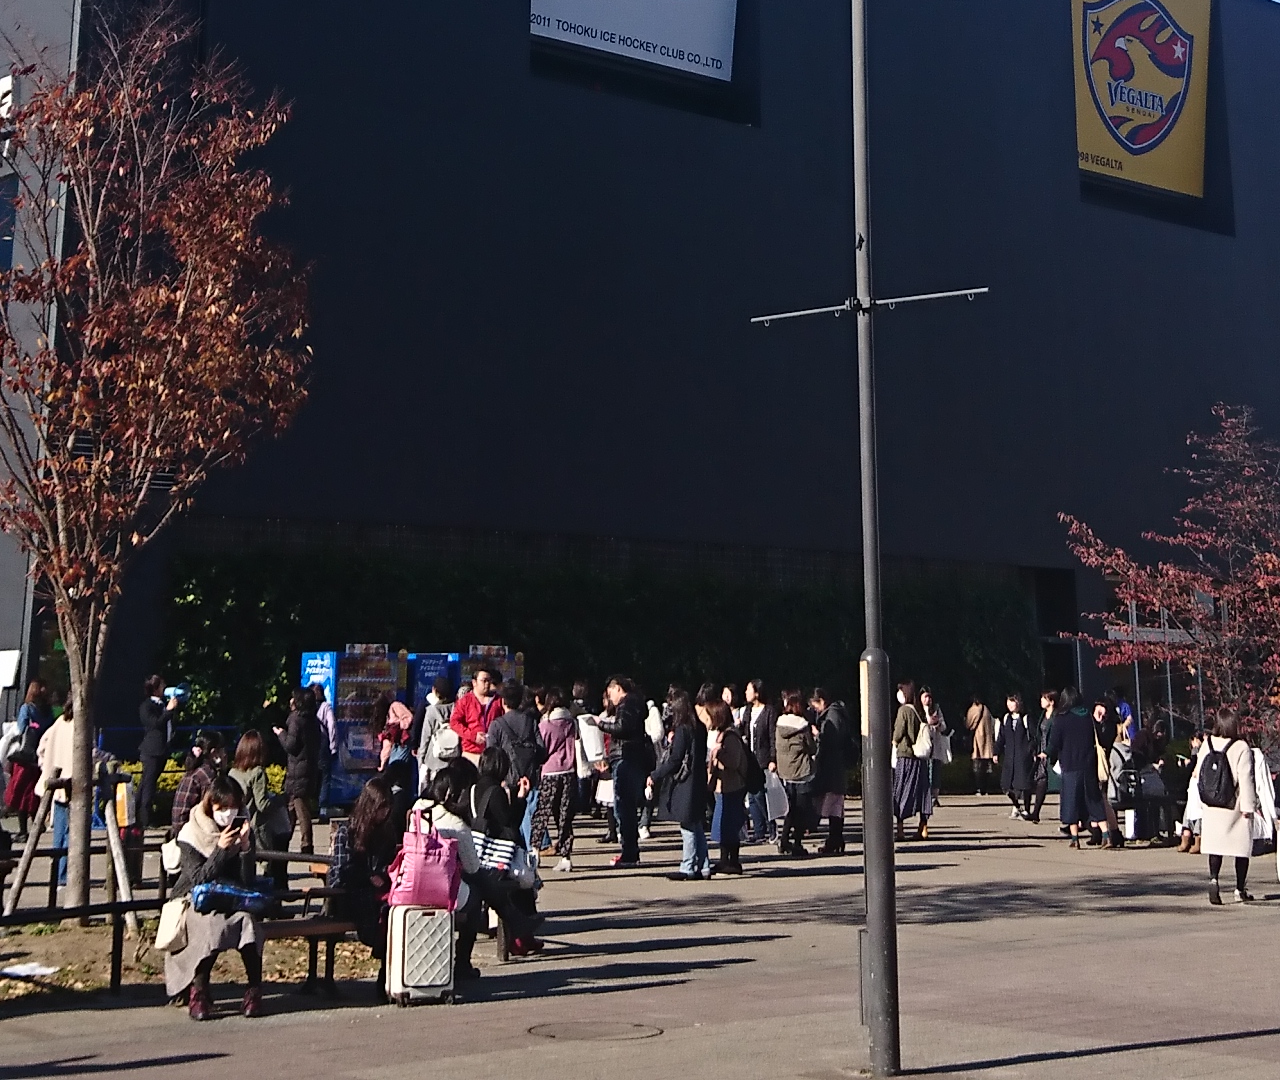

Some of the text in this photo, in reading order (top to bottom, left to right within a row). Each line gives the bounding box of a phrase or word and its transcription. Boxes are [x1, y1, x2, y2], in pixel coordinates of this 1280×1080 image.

[530, 13, 551, 28] 2011
[555, 18, 598, 39] TOHOKU
[600, 30, 617, 44] ICE
[618, 34, 658, 54] HOCKEY
[660, 45, 685, 61] CLUB
[1106, 80, 1166, 115] VEGALTA
[1125, 105, 1157, 119] SENDAI
[1090, 153, 1123, 172] VEGALTA
